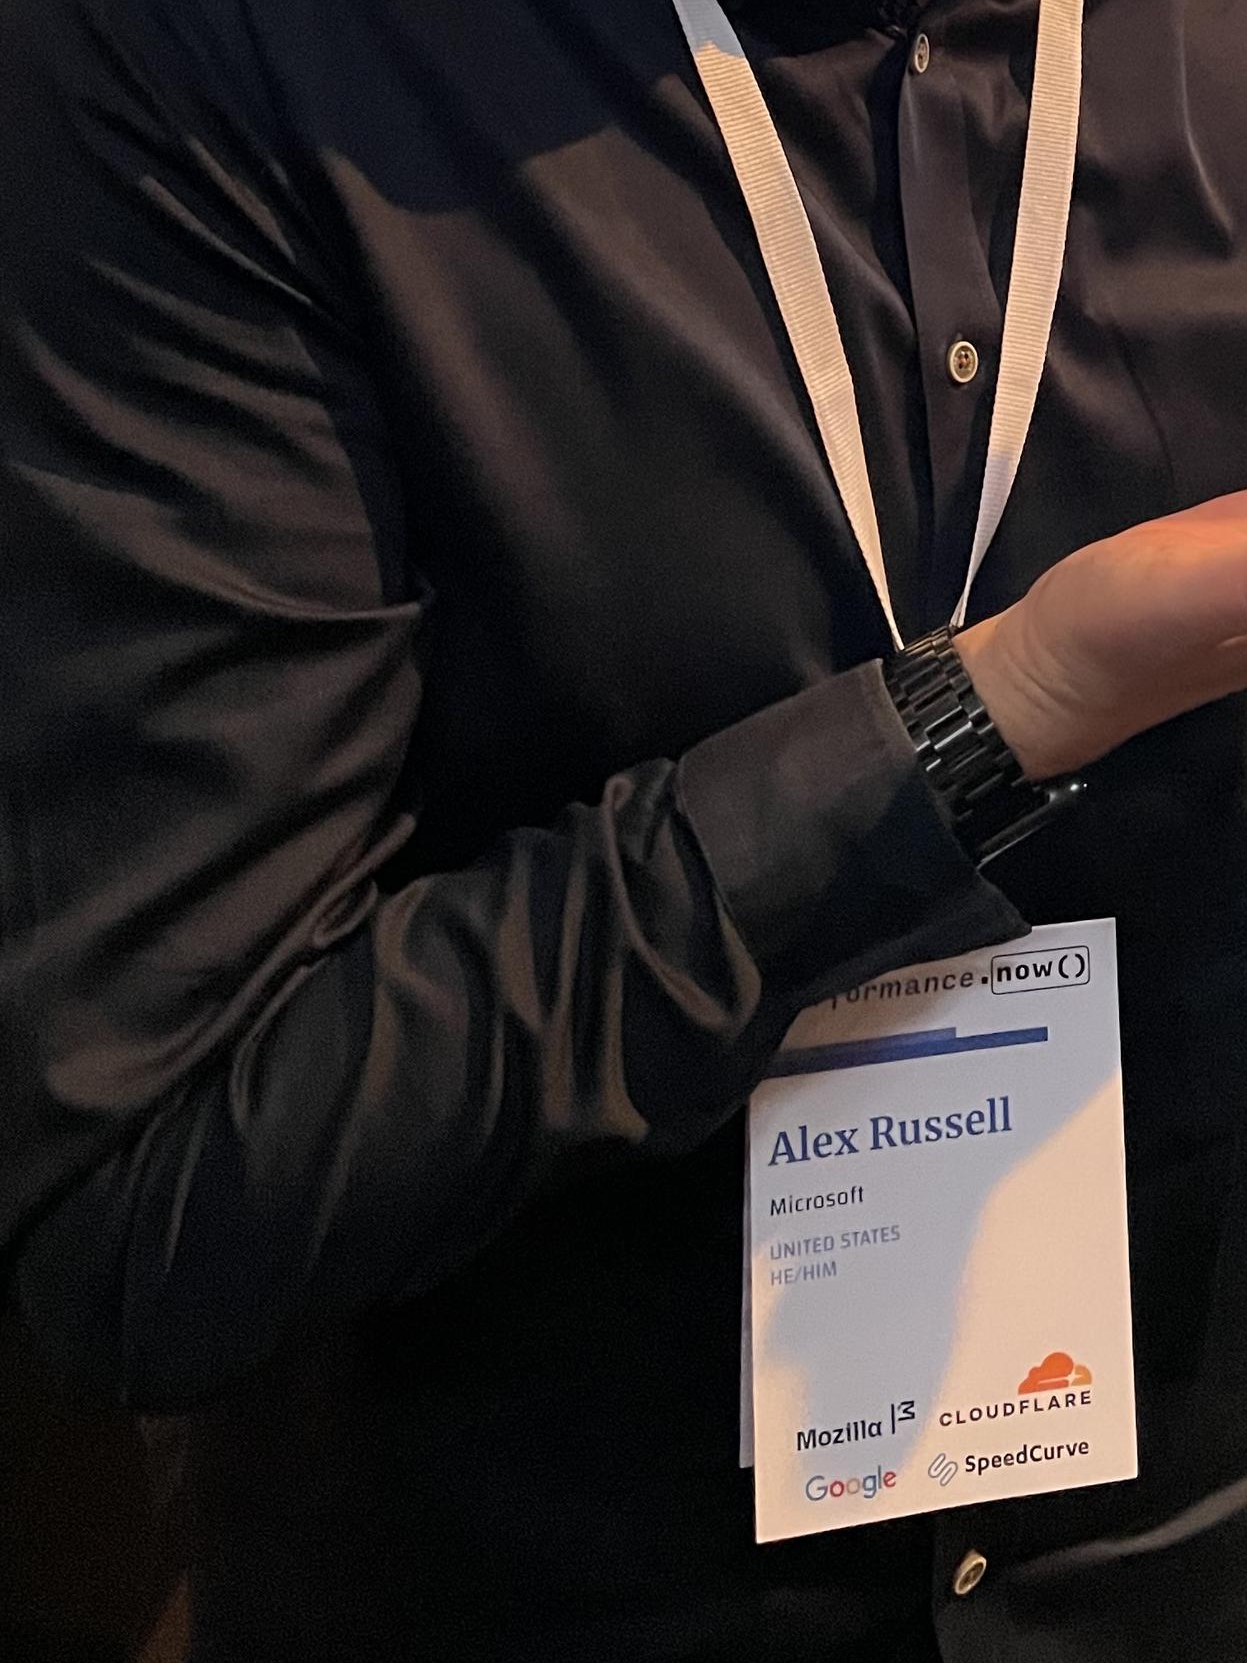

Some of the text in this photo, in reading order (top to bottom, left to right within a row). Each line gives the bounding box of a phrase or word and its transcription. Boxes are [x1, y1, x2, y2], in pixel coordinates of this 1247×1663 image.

[767, 1095, 1013, 1167] Alex Russell
[770, 1185, 865, 1217] Microsoft
[769, 1224, 901, 1261] UNITED STATES
[770, 1260, 837, 1286] HE/HIM
[939, 1390, 1092, 1428] CLOUDFLARE
[796, 1418, 883, 1452] Mozilla
[964, 1439, 1090, 1475] SpeedCurve
[805, 1465, 897, 1502] Google
